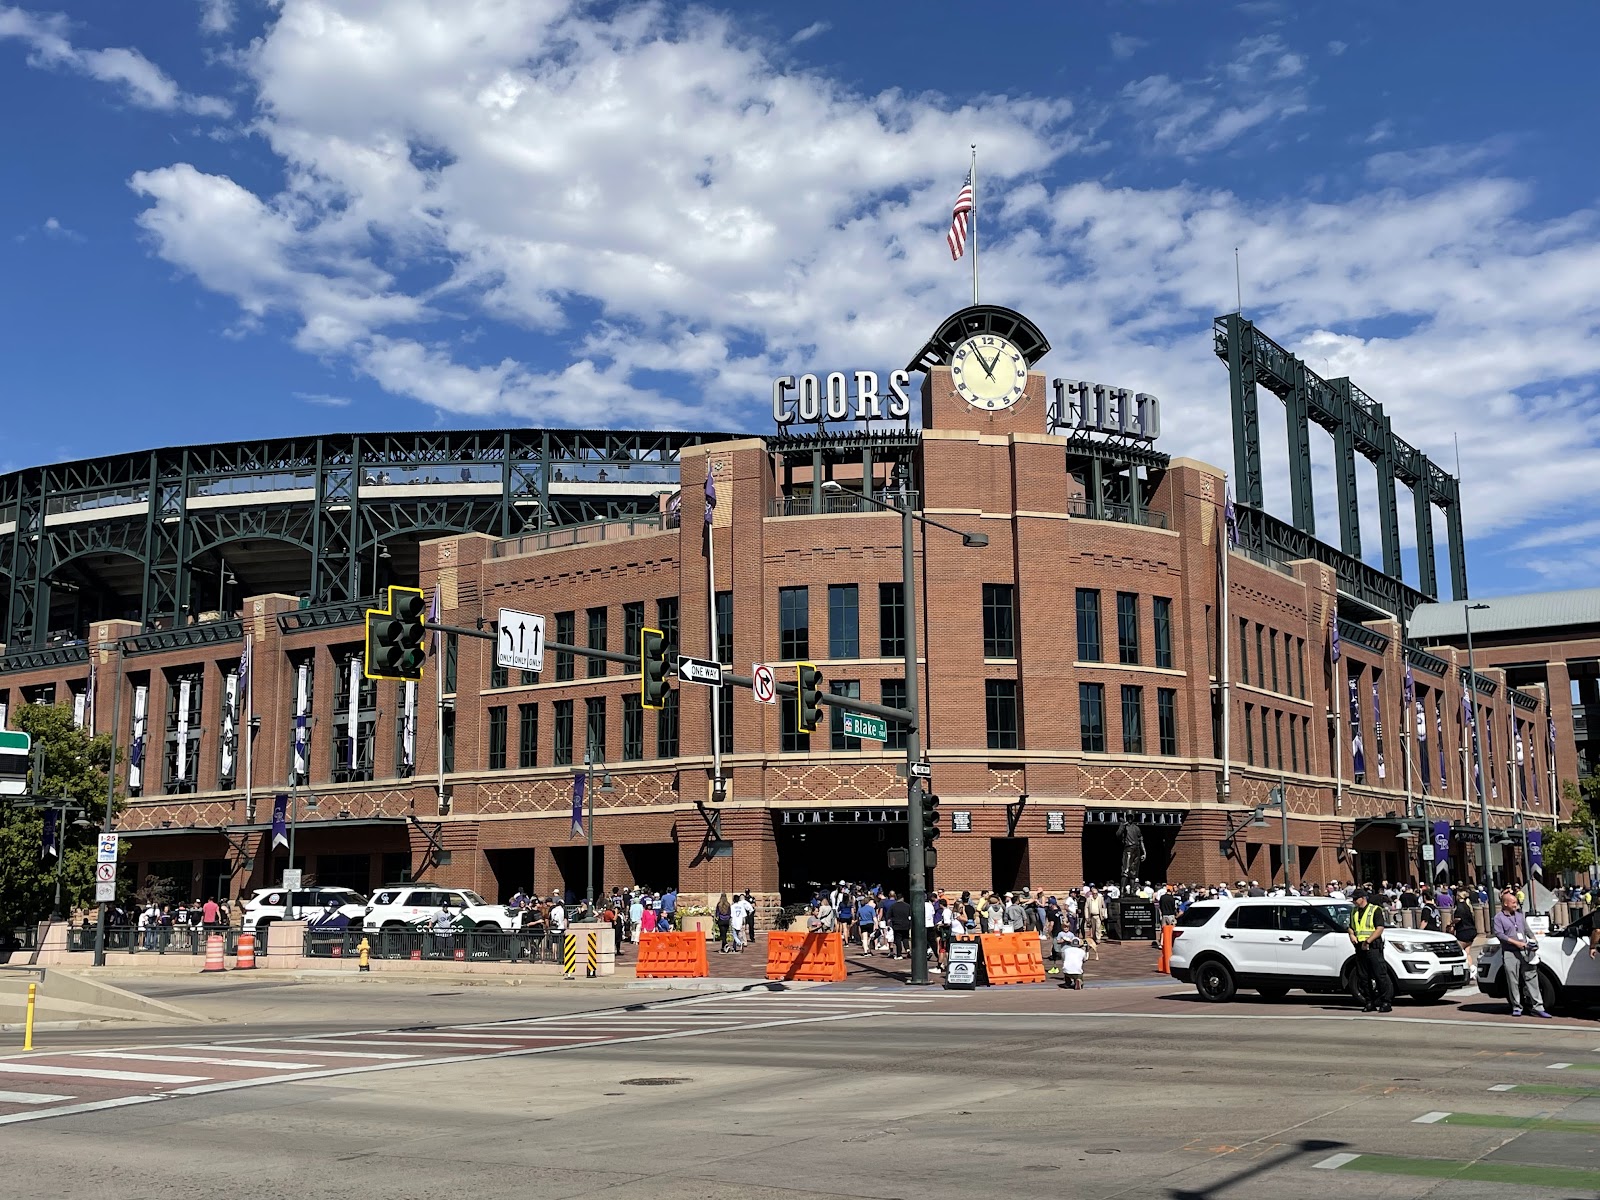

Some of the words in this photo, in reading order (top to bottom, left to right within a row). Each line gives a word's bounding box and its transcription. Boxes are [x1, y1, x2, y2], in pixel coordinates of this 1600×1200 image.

[982, 337, 994, 345] 12
[1001, 341, 1007, 349] 1
[956, 350, 966, 360] 10
[1012, 354, 1020, 362] 2
[954, 367, 961, 375] 9
[1014, 386, 1021, 394] 4
[971, 394, 979, 402] 7
[1003, 396, 1010, 404] 5
[773, 369, 910, 424] COORS
[1053, 378, 1160, 440] FIELD
[500, 653, 512, 663] ONLY
[514, 656, 527, 665] ONLY
[529, 658, 541, 667] ONLY
[691, 665, 704, 677] ONE
[704, 667, 717, 679] WAY
[854, 719, 877, 737] Blake
[783, 811, 835, 823] HOME
[854, 810, 900, 822] PLAT
[1141, 812, 1182, 824] PLATE
